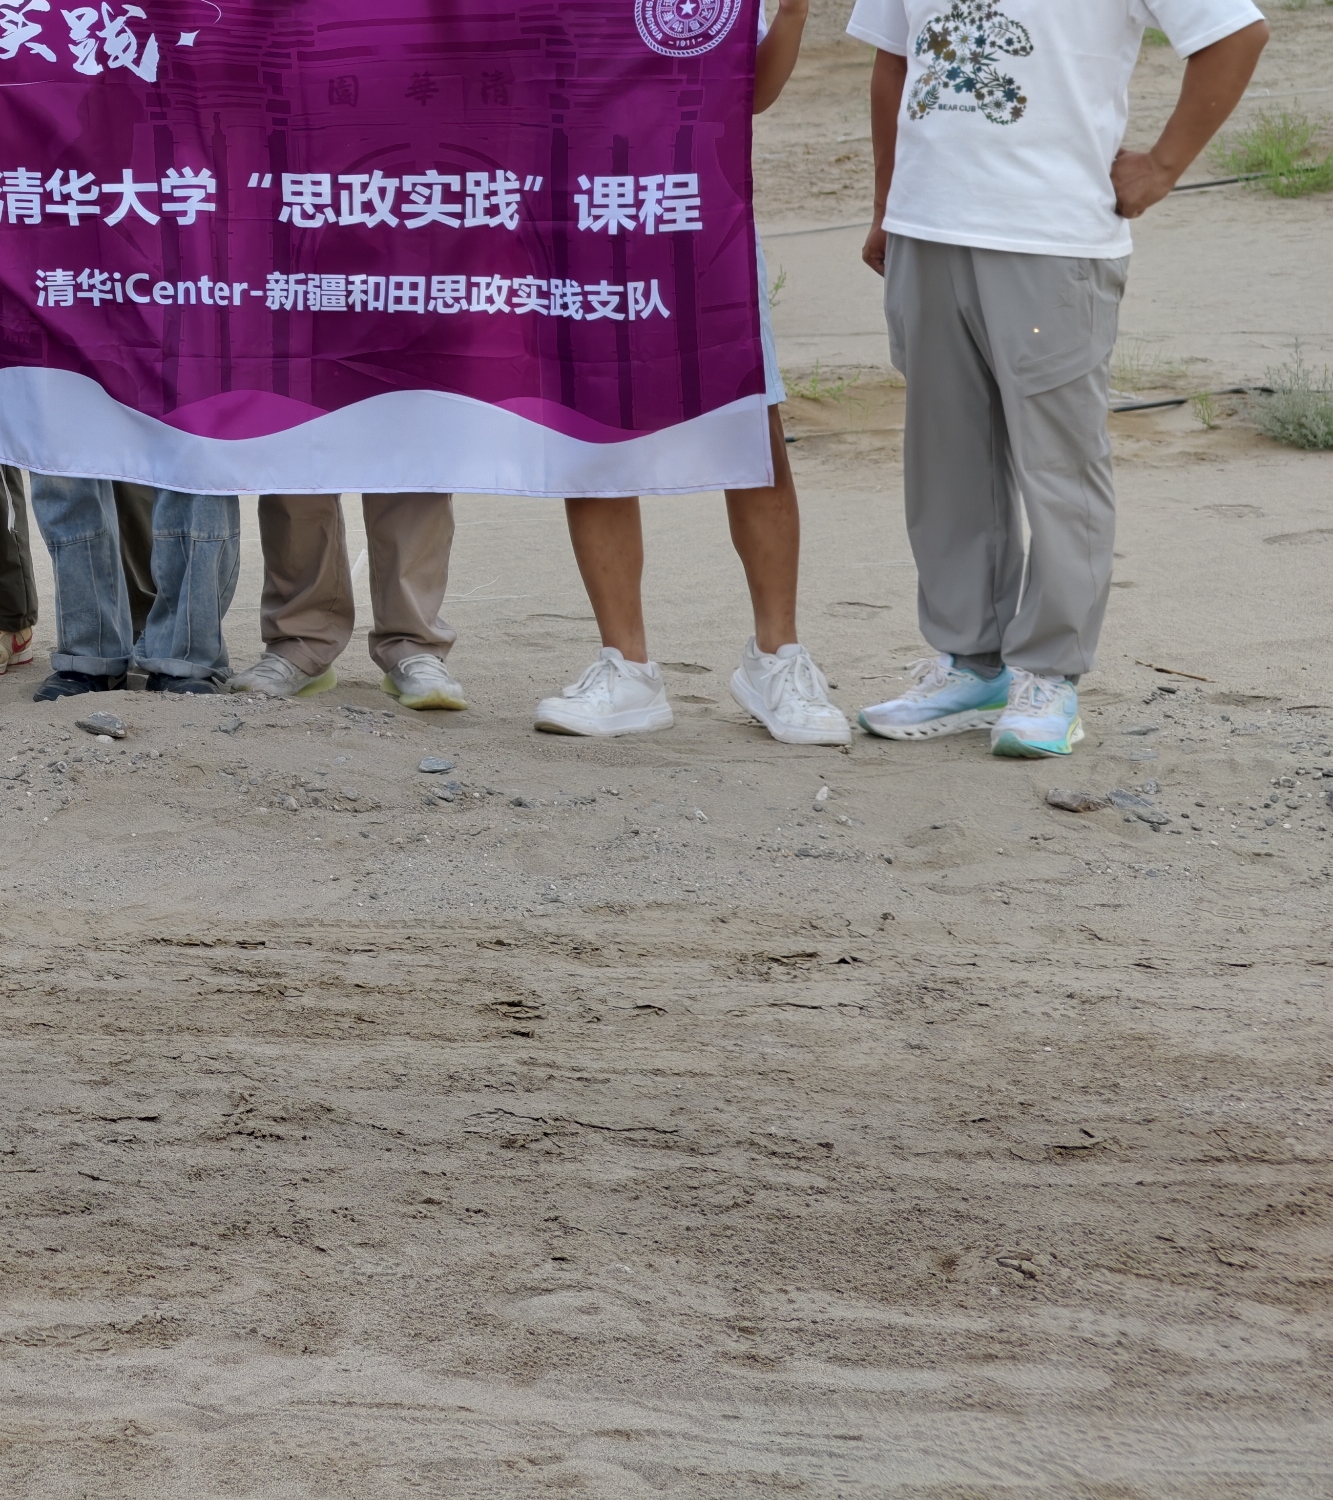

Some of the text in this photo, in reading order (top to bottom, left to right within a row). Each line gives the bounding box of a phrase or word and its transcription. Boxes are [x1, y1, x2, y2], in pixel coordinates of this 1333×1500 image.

[938, 103, 957, 111] BEAR
[35, 267, 670, 321] 清华iCenter-新疆和田思政实践支队
